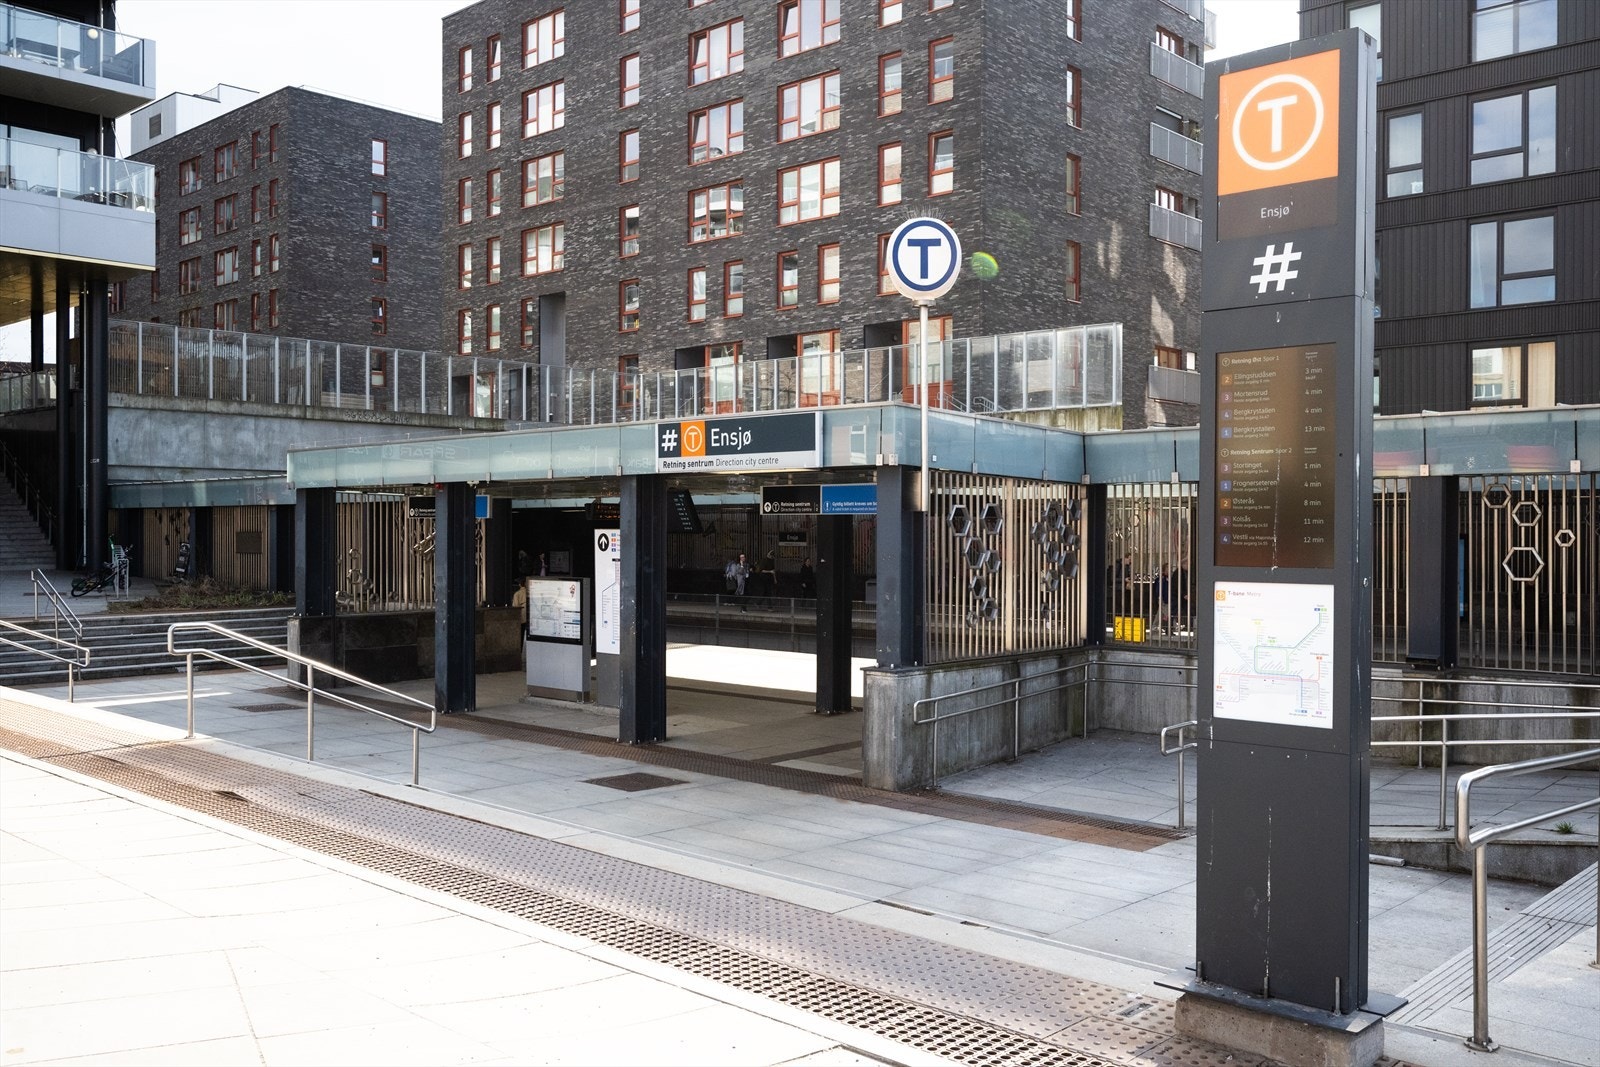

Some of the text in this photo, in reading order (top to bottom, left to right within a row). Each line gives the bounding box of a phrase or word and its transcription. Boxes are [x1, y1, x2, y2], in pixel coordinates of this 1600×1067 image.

[1260, 206, 1290, 219] Ensjø
[1234, 371, 1276, 380] Ellingsrudåsen
[1234, 408, 1276, 416] Bergkrystallen
[1234, 426, 1275, 434] Bergkrystallen
[711, 426, 752, 450] Ensjø
[662, 460, 686, 469] Retning
[688, 459, 714, 467] sentrum
[716, 458, 743, 466] Direction
[745, 458, 756, 467] city
